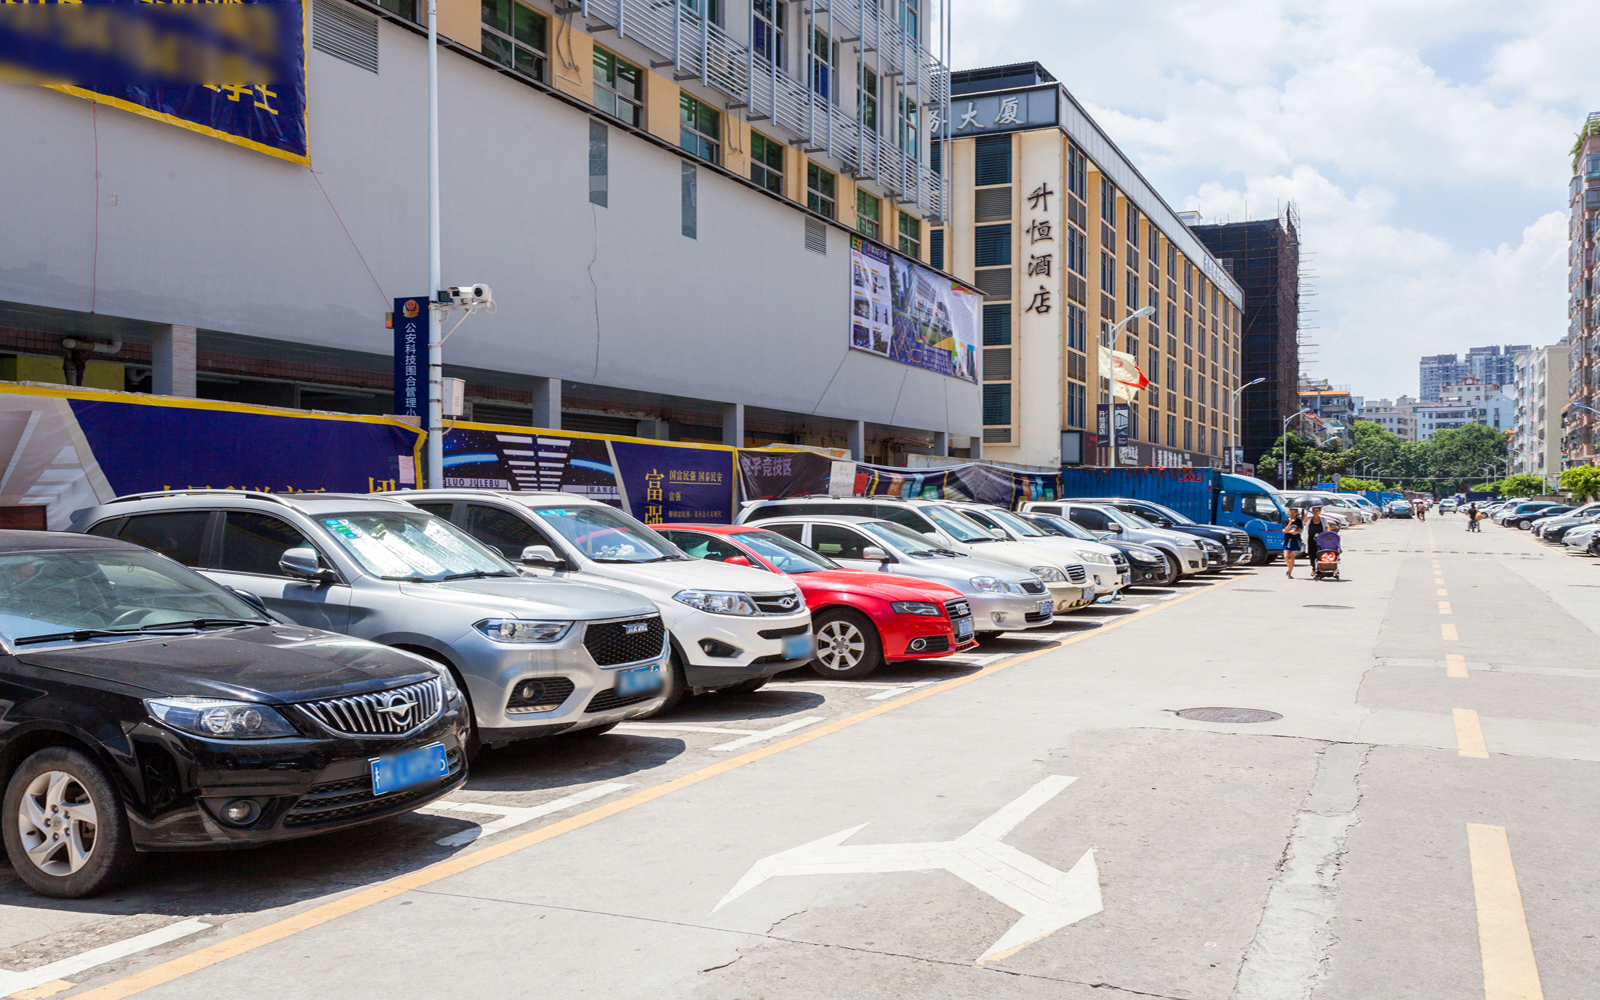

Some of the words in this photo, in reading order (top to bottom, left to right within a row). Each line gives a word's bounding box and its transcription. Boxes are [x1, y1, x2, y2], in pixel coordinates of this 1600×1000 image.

[1025, 182, 1054, 315] 升恒酒店
[405, 322, 417, 416] 公安科技围合管理小
[469, 478, 500, 487] JULEBU
[644, 468, 665, 524] 富强
[669, 469, 697, 481] 国富民强
